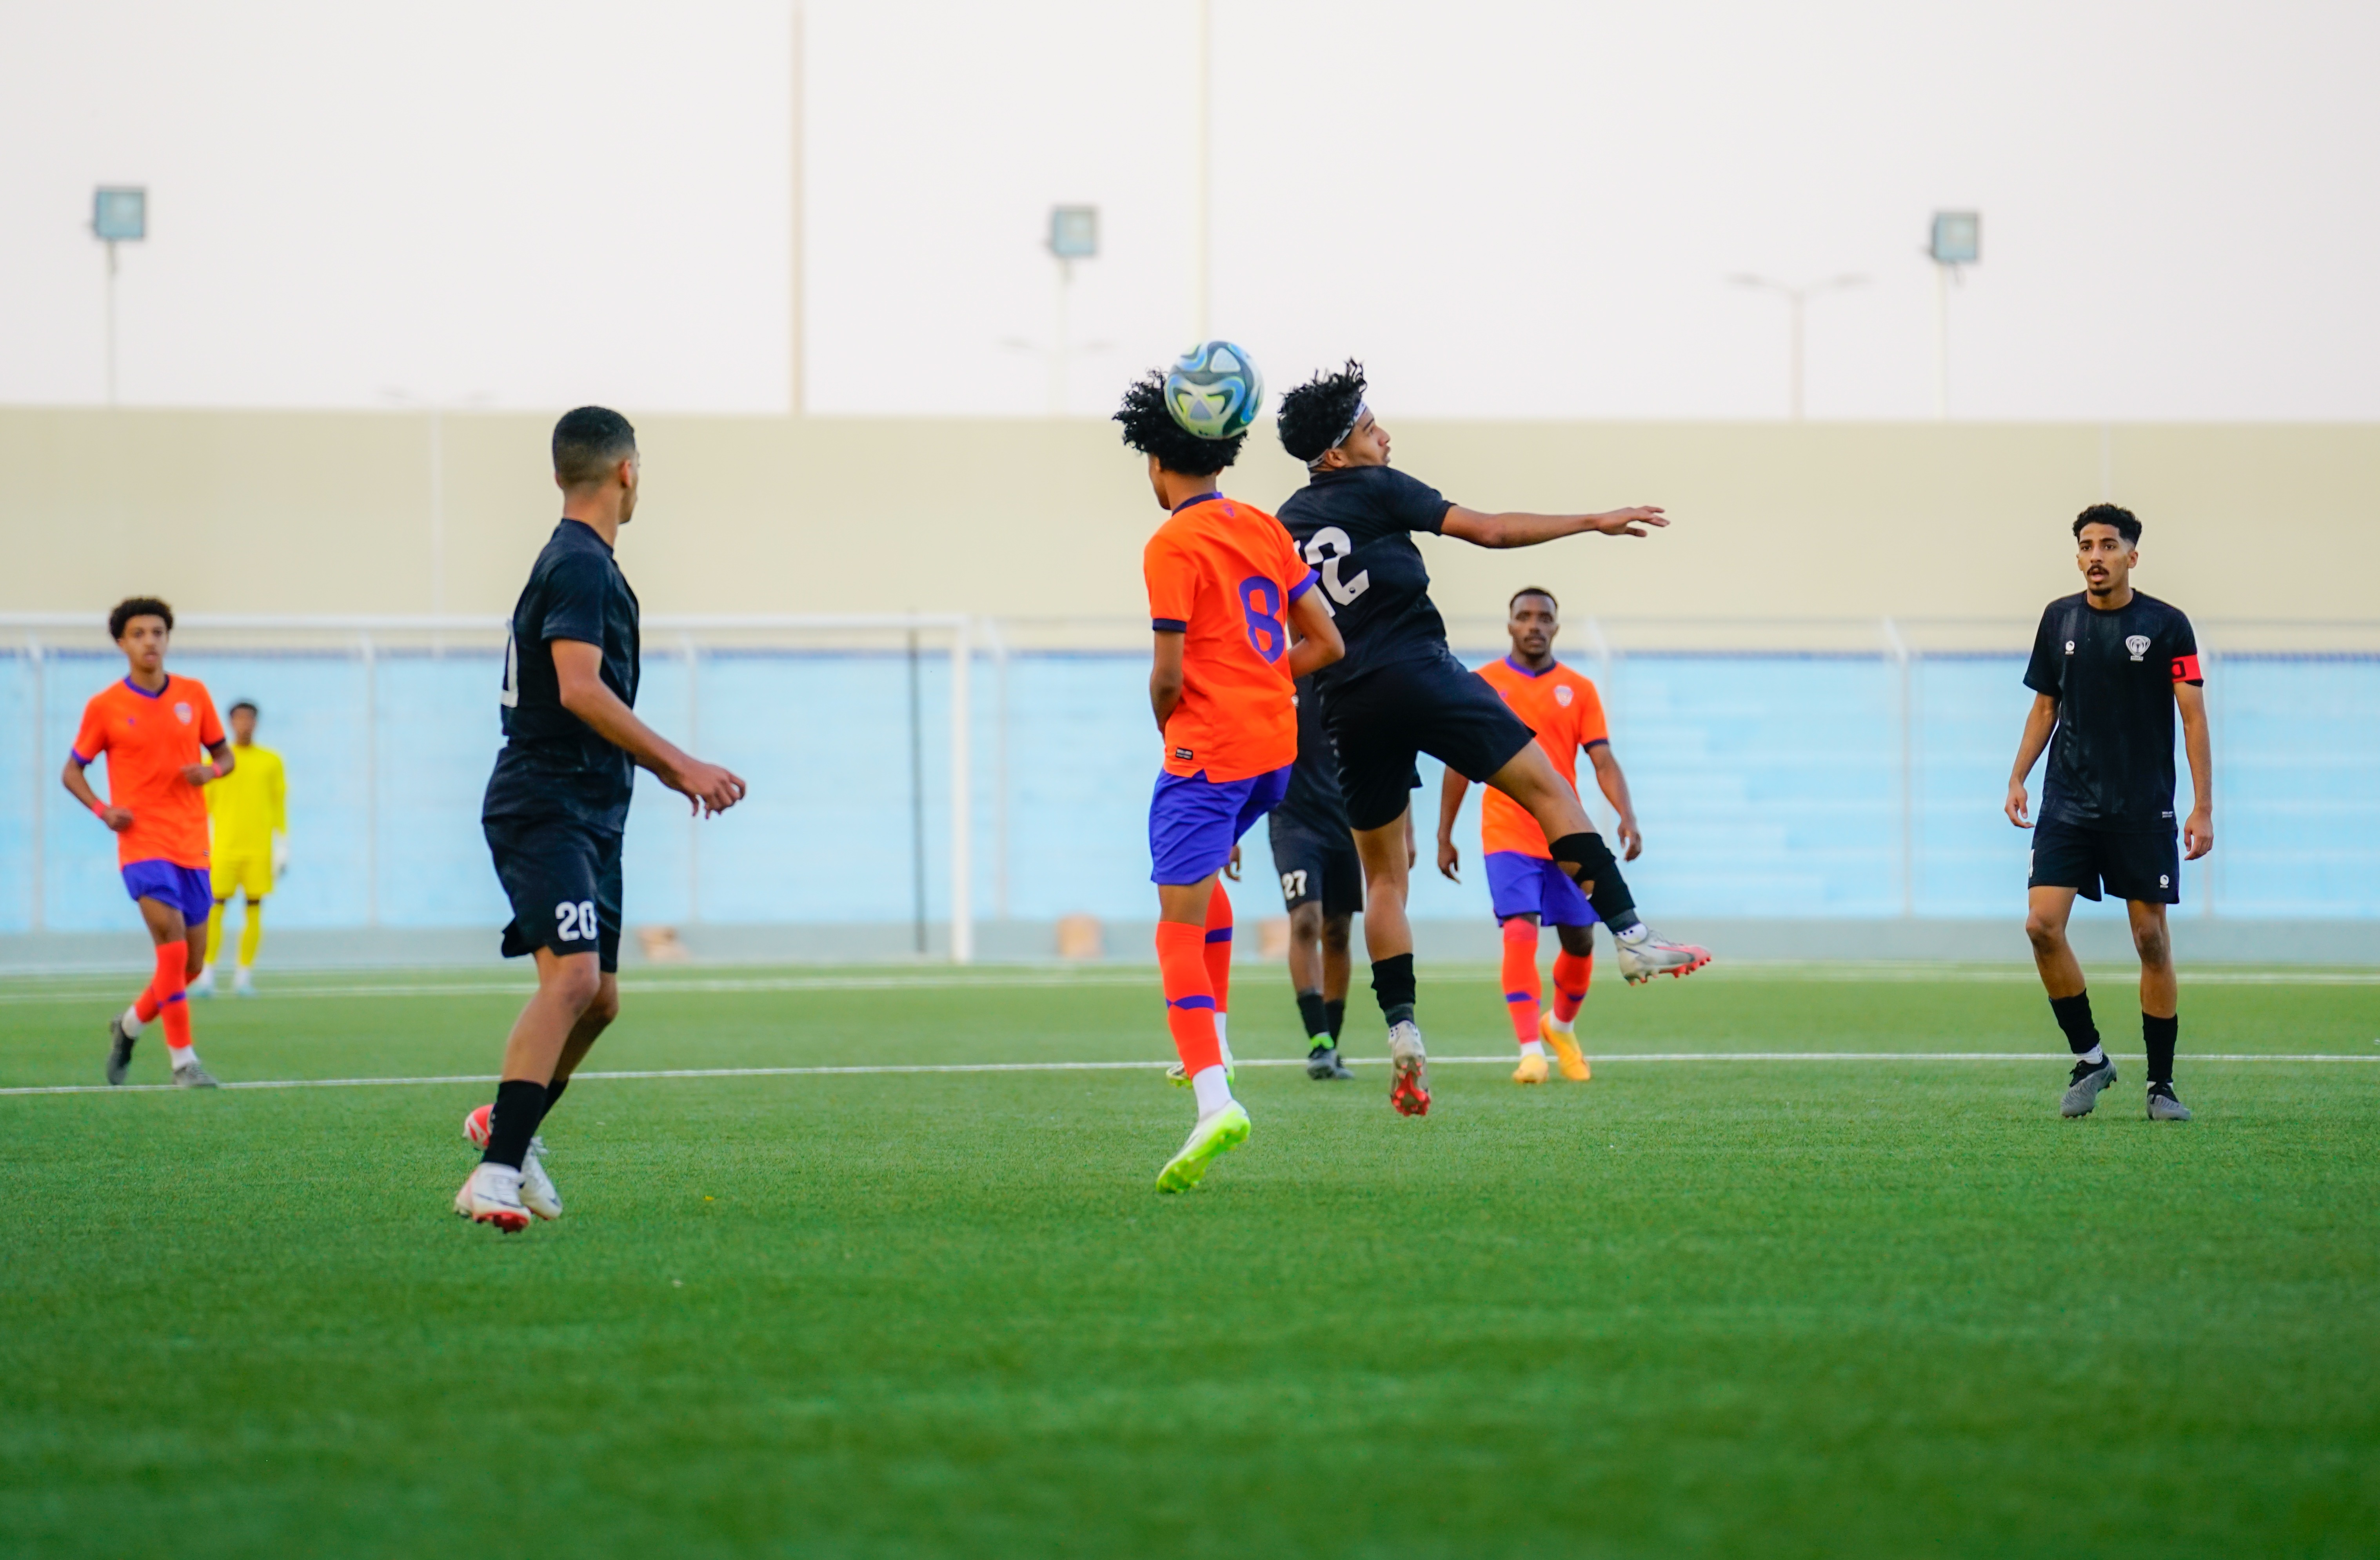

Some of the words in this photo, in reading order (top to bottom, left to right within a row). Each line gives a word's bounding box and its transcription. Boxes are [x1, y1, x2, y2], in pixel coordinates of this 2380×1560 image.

[1239, 576, 1284, 664] 8
[1282, 869, 1307, 900] 27
[555, 900, 597, 942] 20
